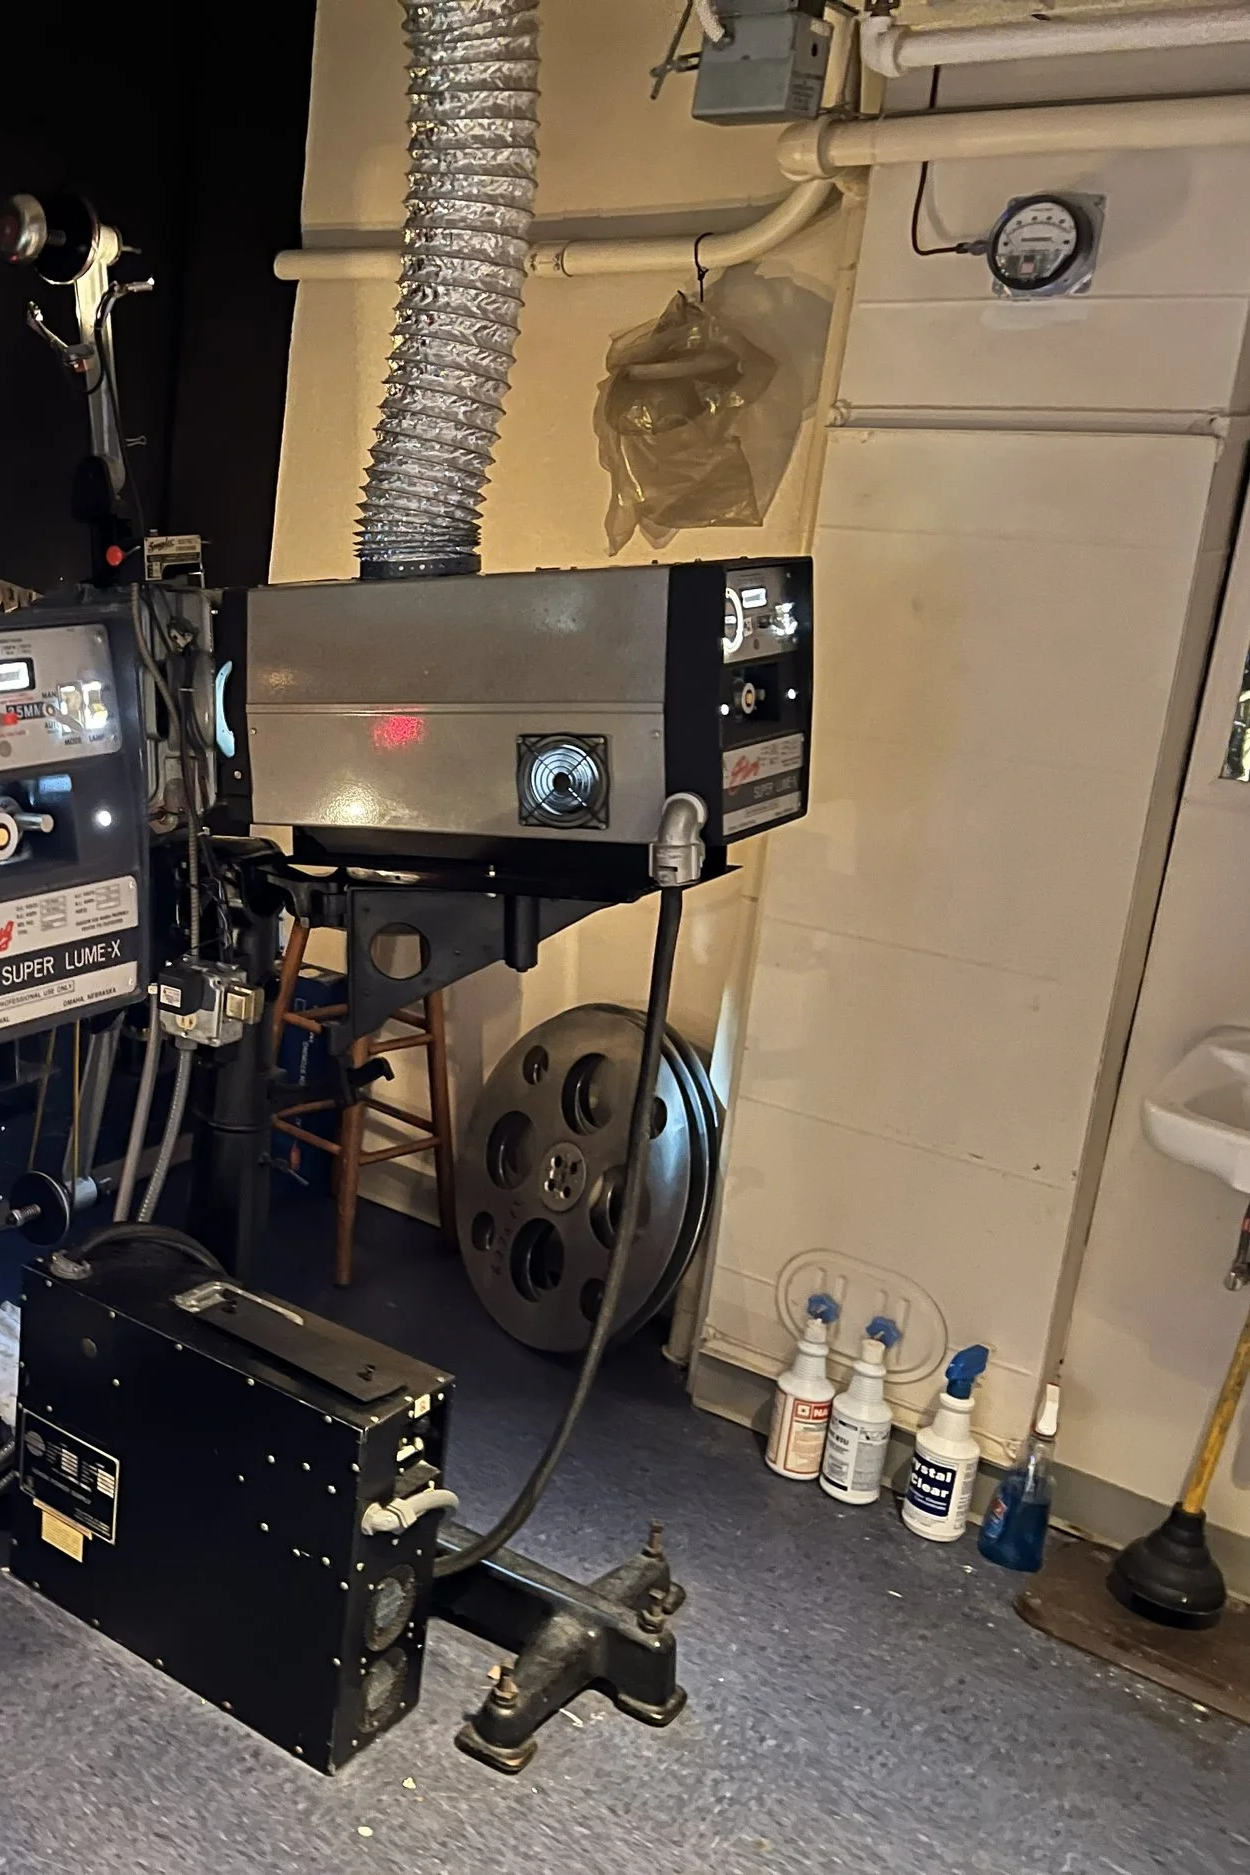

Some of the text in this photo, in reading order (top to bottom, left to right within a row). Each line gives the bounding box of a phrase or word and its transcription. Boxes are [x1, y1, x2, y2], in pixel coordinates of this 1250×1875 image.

[1, 939, 121, 986] SUPER LUME-X
[43, 987, 55, 997] USE
[56, 983, 72, 993] ONLY
[86, 987, 117, 1001] NEBRASKA
[911, 1472, 950, 1499] Clear
